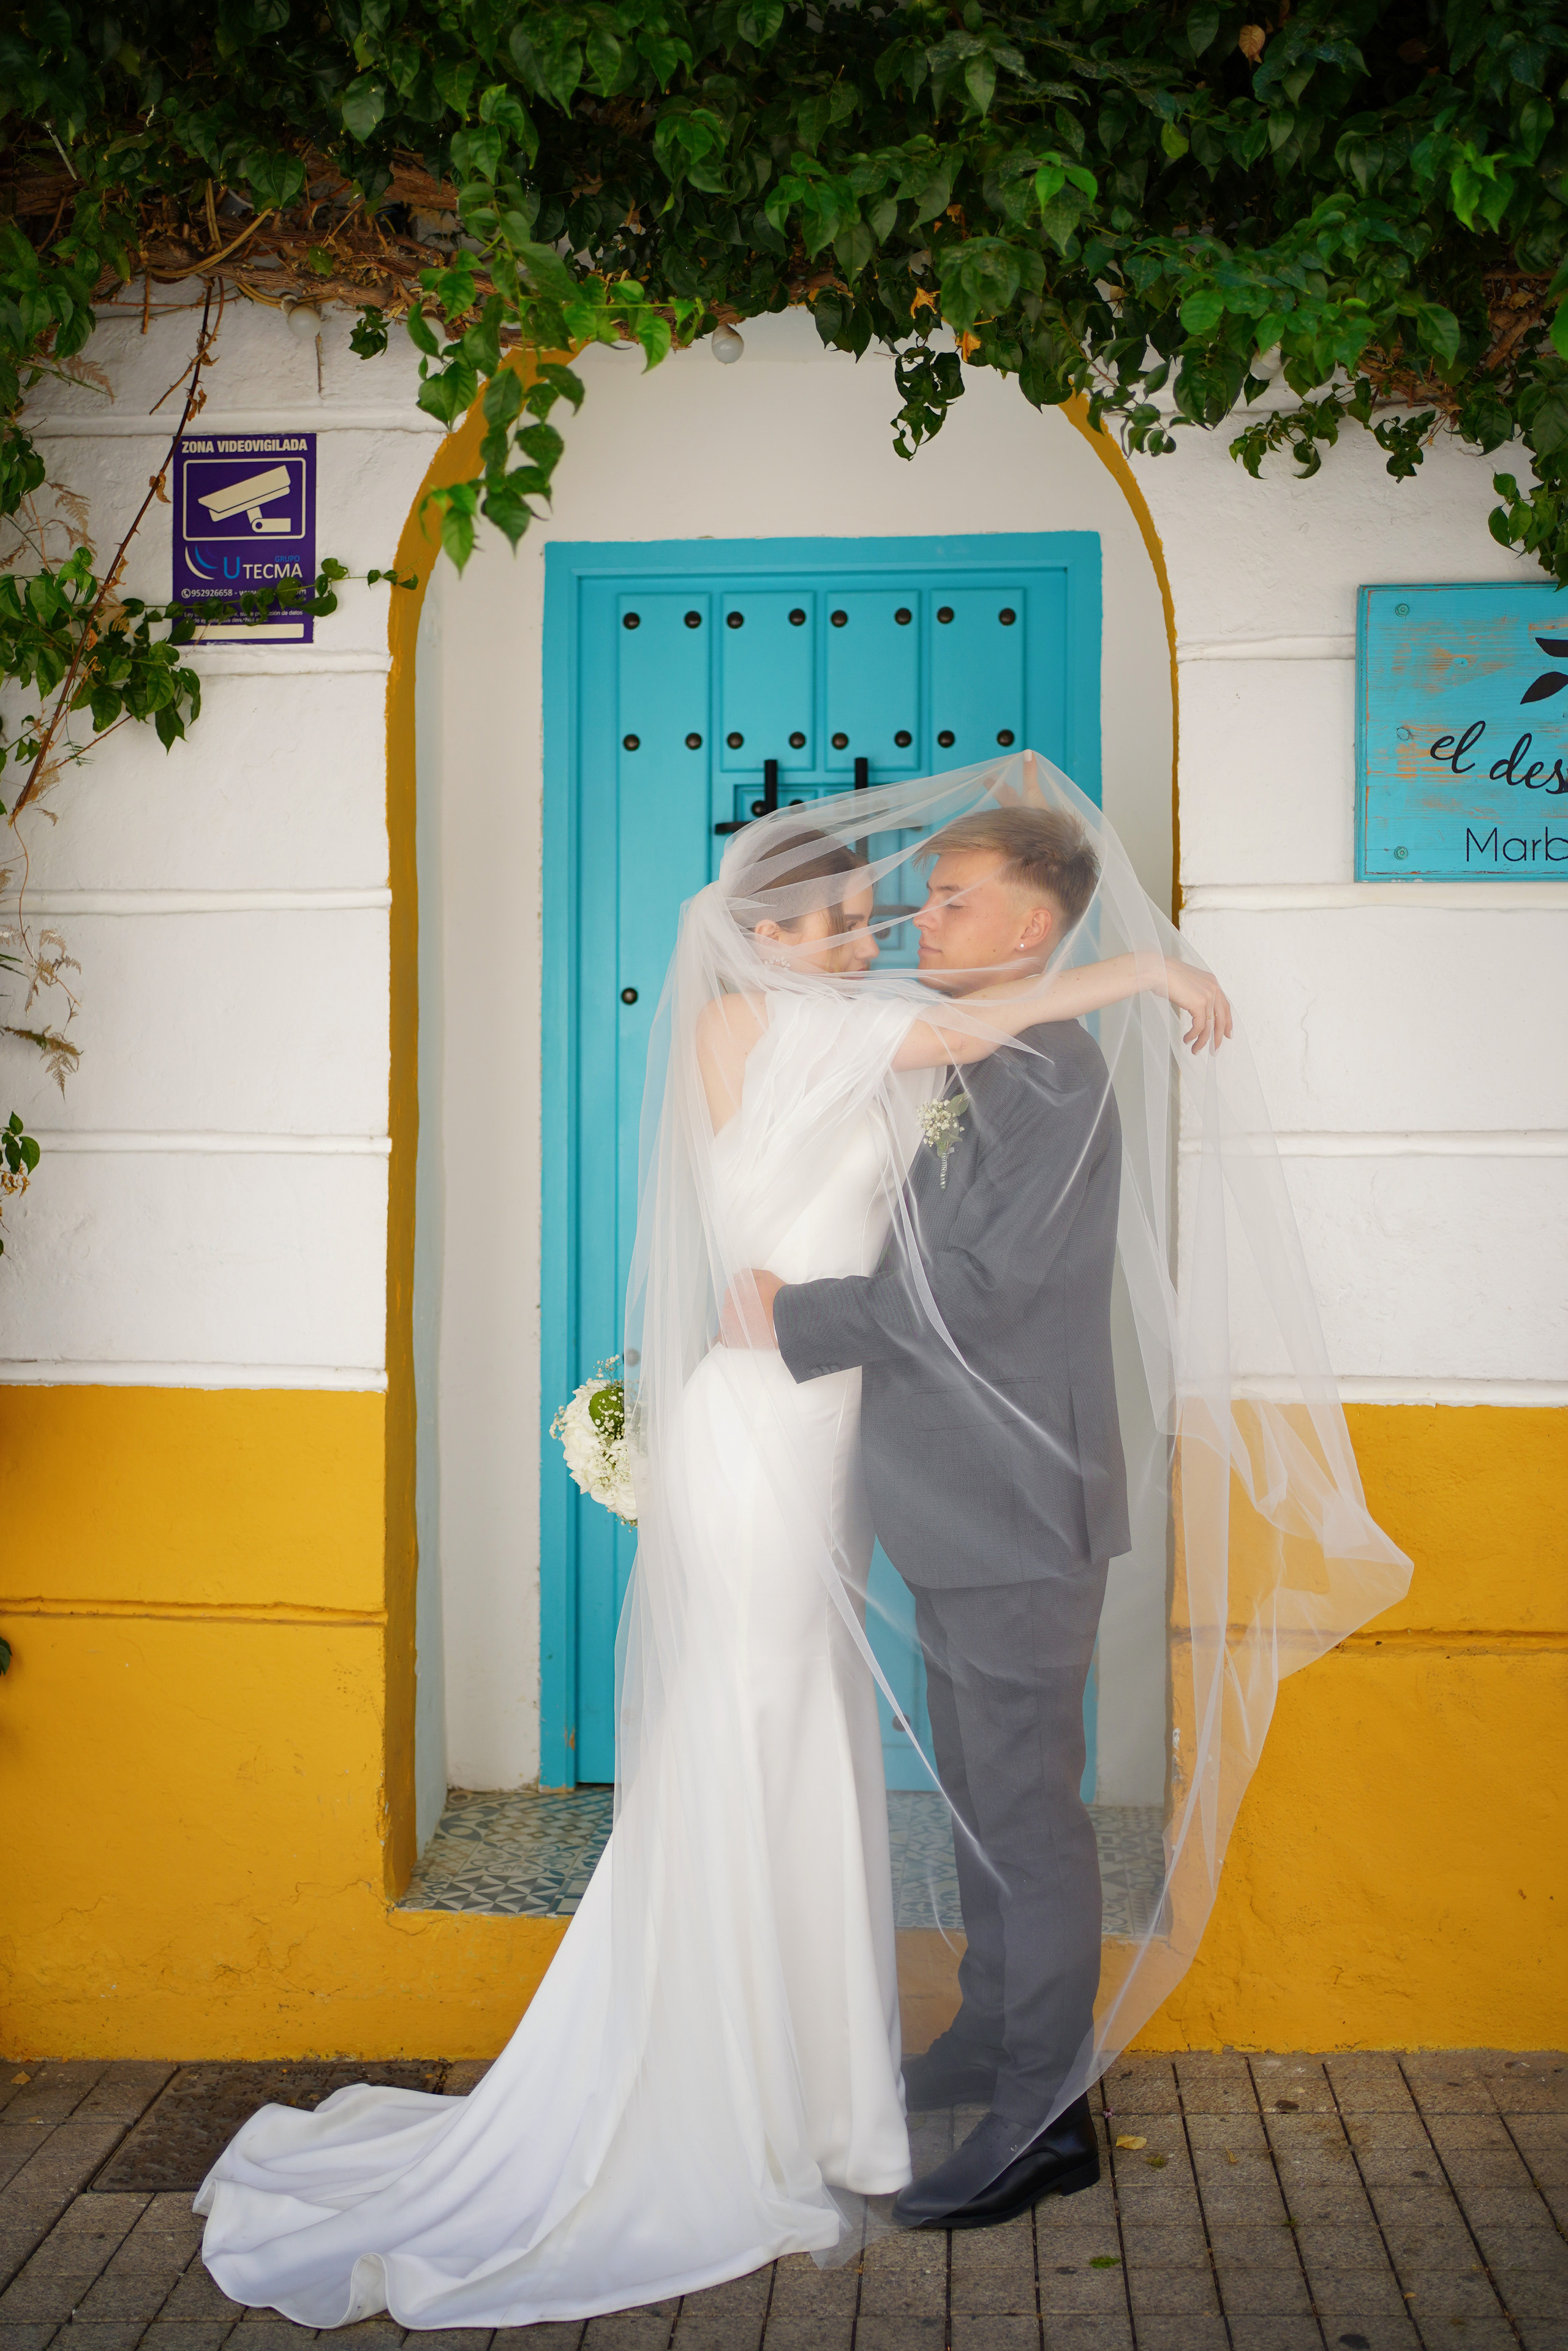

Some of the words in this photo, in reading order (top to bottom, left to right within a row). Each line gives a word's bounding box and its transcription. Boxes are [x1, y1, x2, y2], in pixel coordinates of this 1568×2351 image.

[182, 440, 214, 453] ZONA
[217, 439, 307, 453] VIDEOVIGILADA
[191, 589, 233, 597] 952926658
[1430, 720, 1486, 774] el
[1466, 826, 1568, 862] Marb
